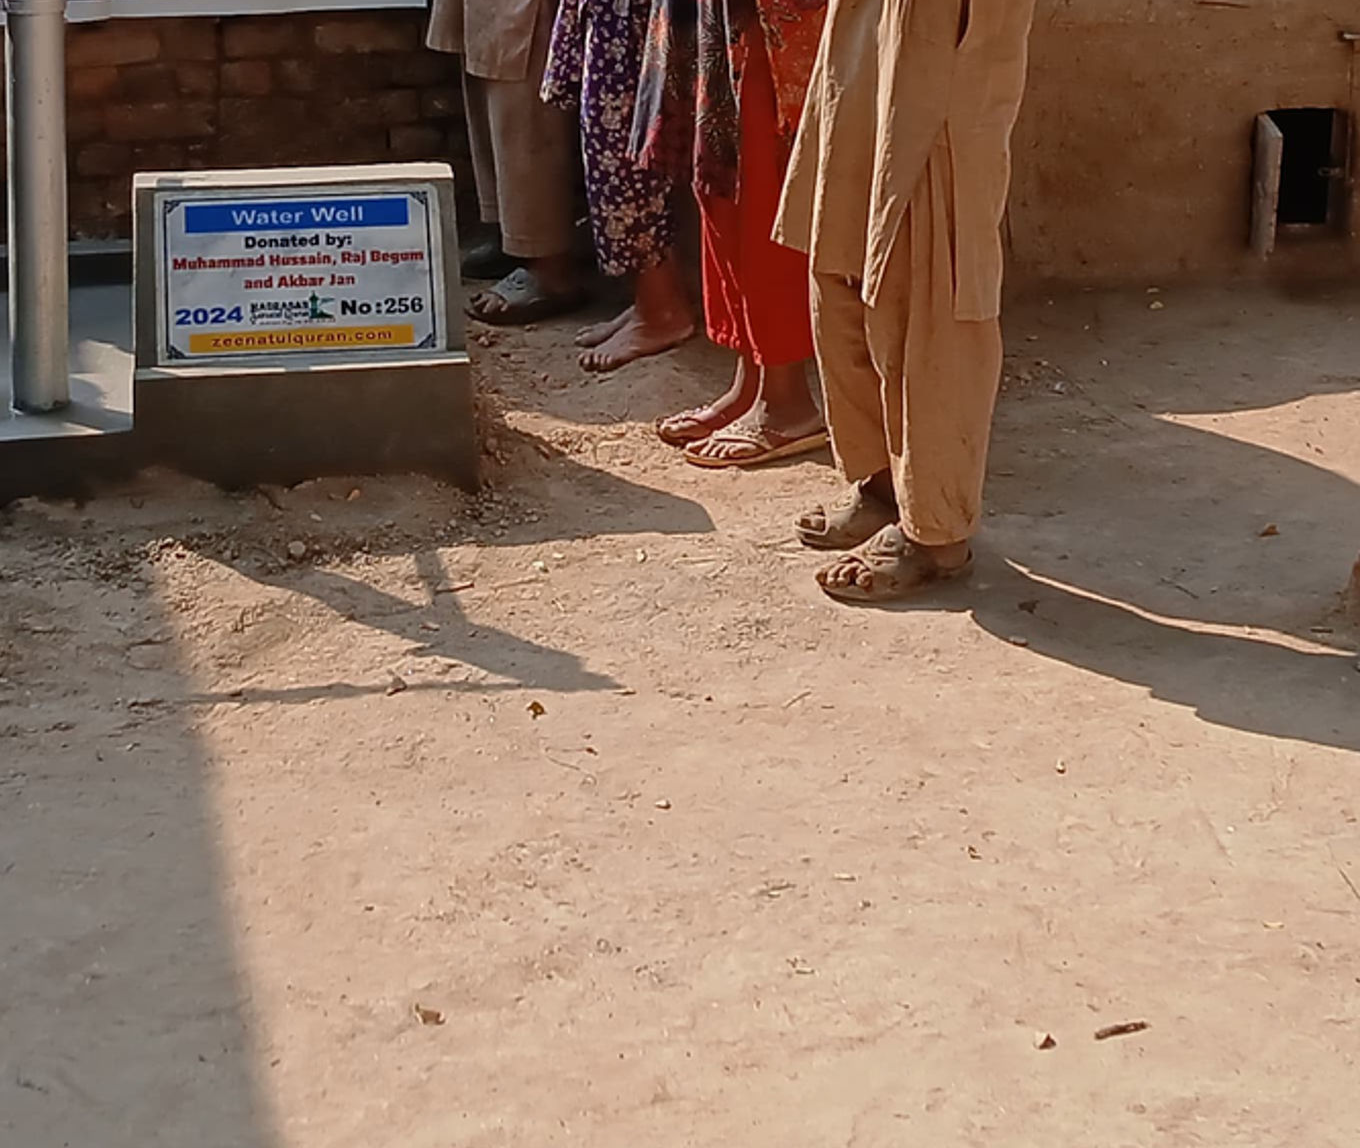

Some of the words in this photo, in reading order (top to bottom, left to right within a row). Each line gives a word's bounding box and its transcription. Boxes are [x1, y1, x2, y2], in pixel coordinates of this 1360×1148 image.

[232, 209, 304, 226] Water
[311, 205, 363, 222] Well
[244, 233, 320, 249] Donated
[325, 232, 353, 249] by:
[172, 253, 265, 271] Muhammad
[268, 252, 337, 267] Hussain,
[340, 249, 366, 266] Raj
[370, 249, 425, 265] Begum
[243, 275, 273, 289] and
[278, 273, 325, 289] Akbar
[329, 273, 356, 286] Jan
[175, 305, 244, 326] 2024
[211, 329, 393, 348] zeenatulquran.com
